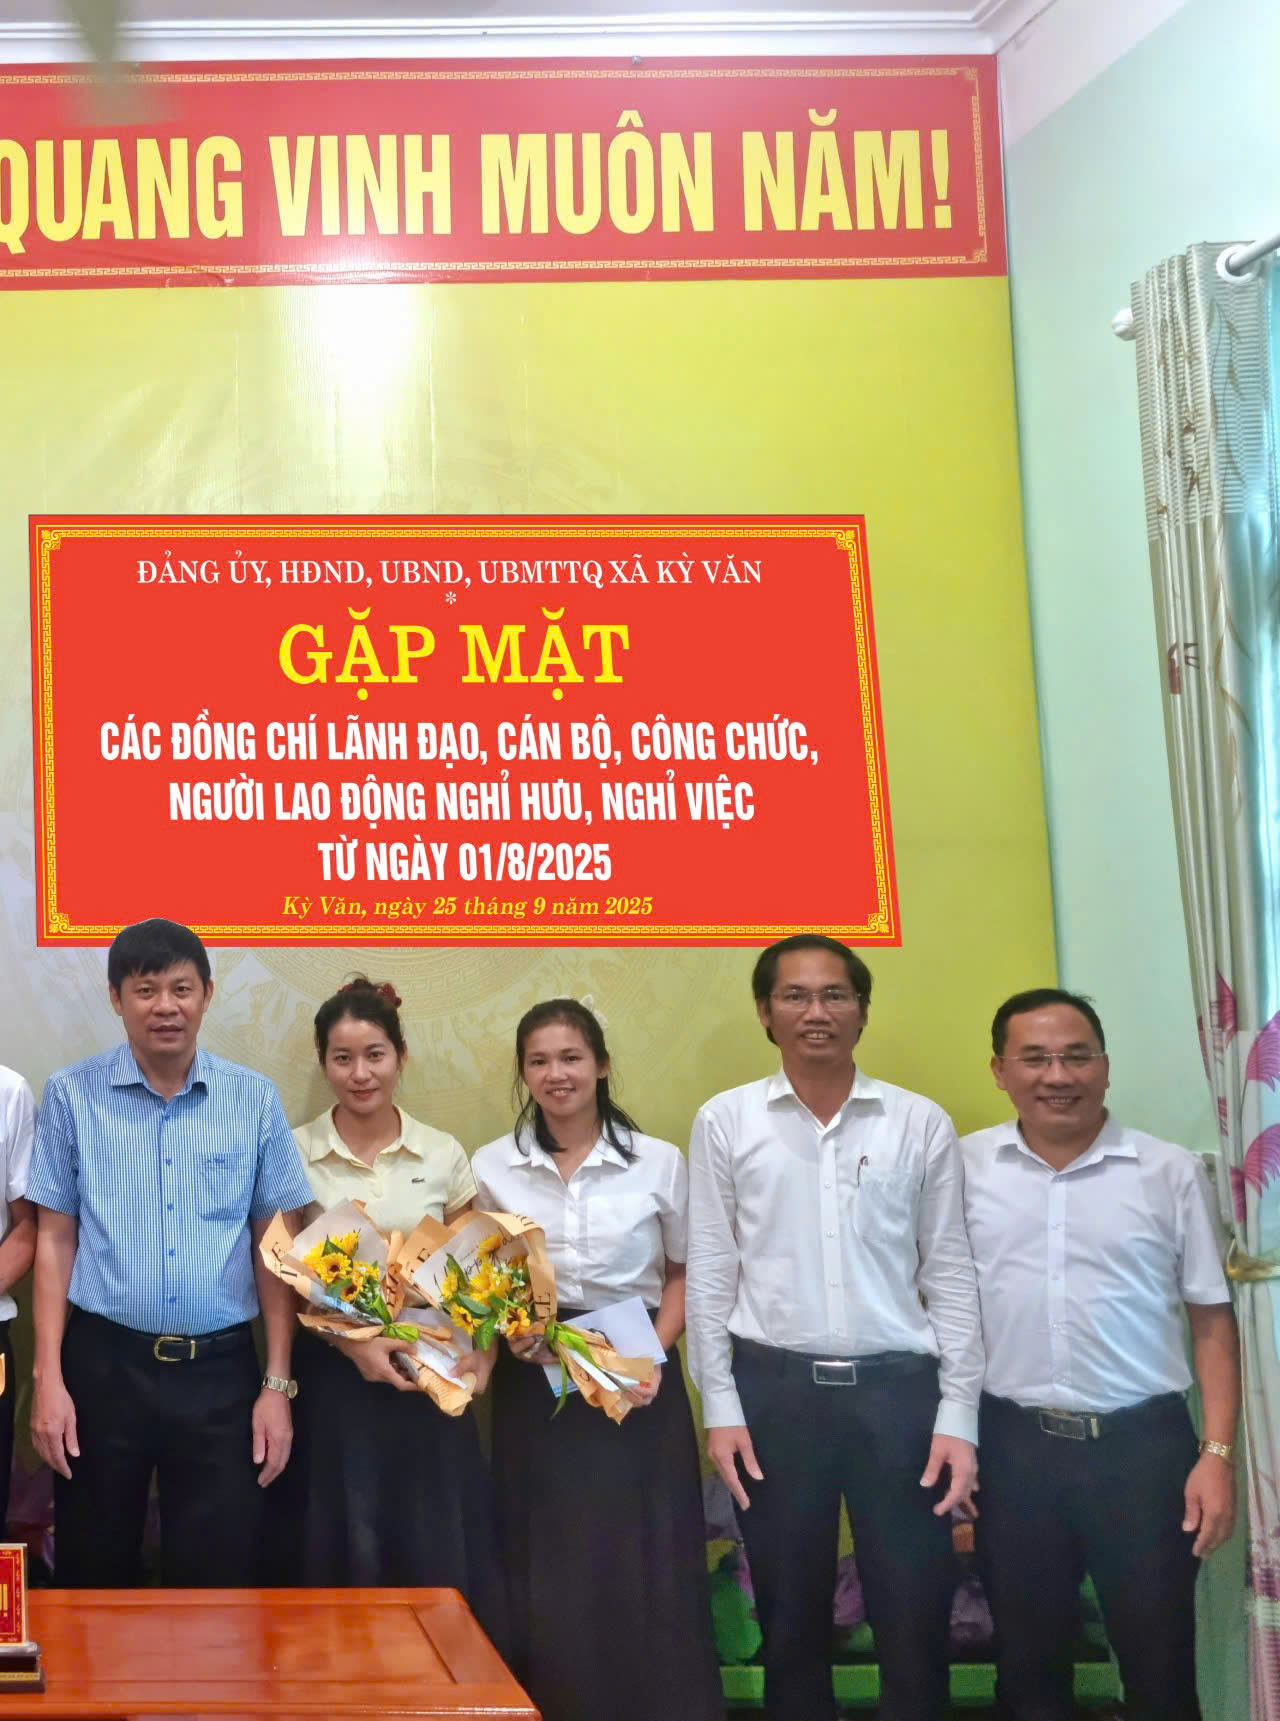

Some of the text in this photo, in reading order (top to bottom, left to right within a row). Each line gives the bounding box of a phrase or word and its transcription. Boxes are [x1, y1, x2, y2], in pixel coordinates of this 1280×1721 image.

[269, 133, 452, 237] VINH
[480, 109, 715, 235] MUÔN
[742, 108, 953, 233] NĂM!
[137, 550, 761, 589] ĐẢNG ỦY, HĐND, UBND, UBMTTQ XÃ KỲ VĂN
[278, 606, 630, 701] GẶP MẶT
[100, 708, 819, 769] CÁC ĐỒNG CHÍ LÃNH ĐẠO, CÁN BỘ, CÔNG CHỨC,
[169, 768, 755, 830] NGƯỜI LAO ĐỘNG NGHỈ HƯU, NGHỈ VIỆC
[317, 834, 612, 881] TỪ NGÀY 01/8/2025
[281, 895, 653, 919] Kỳ Văn, ngày 25 tháng 9 năm 2025
